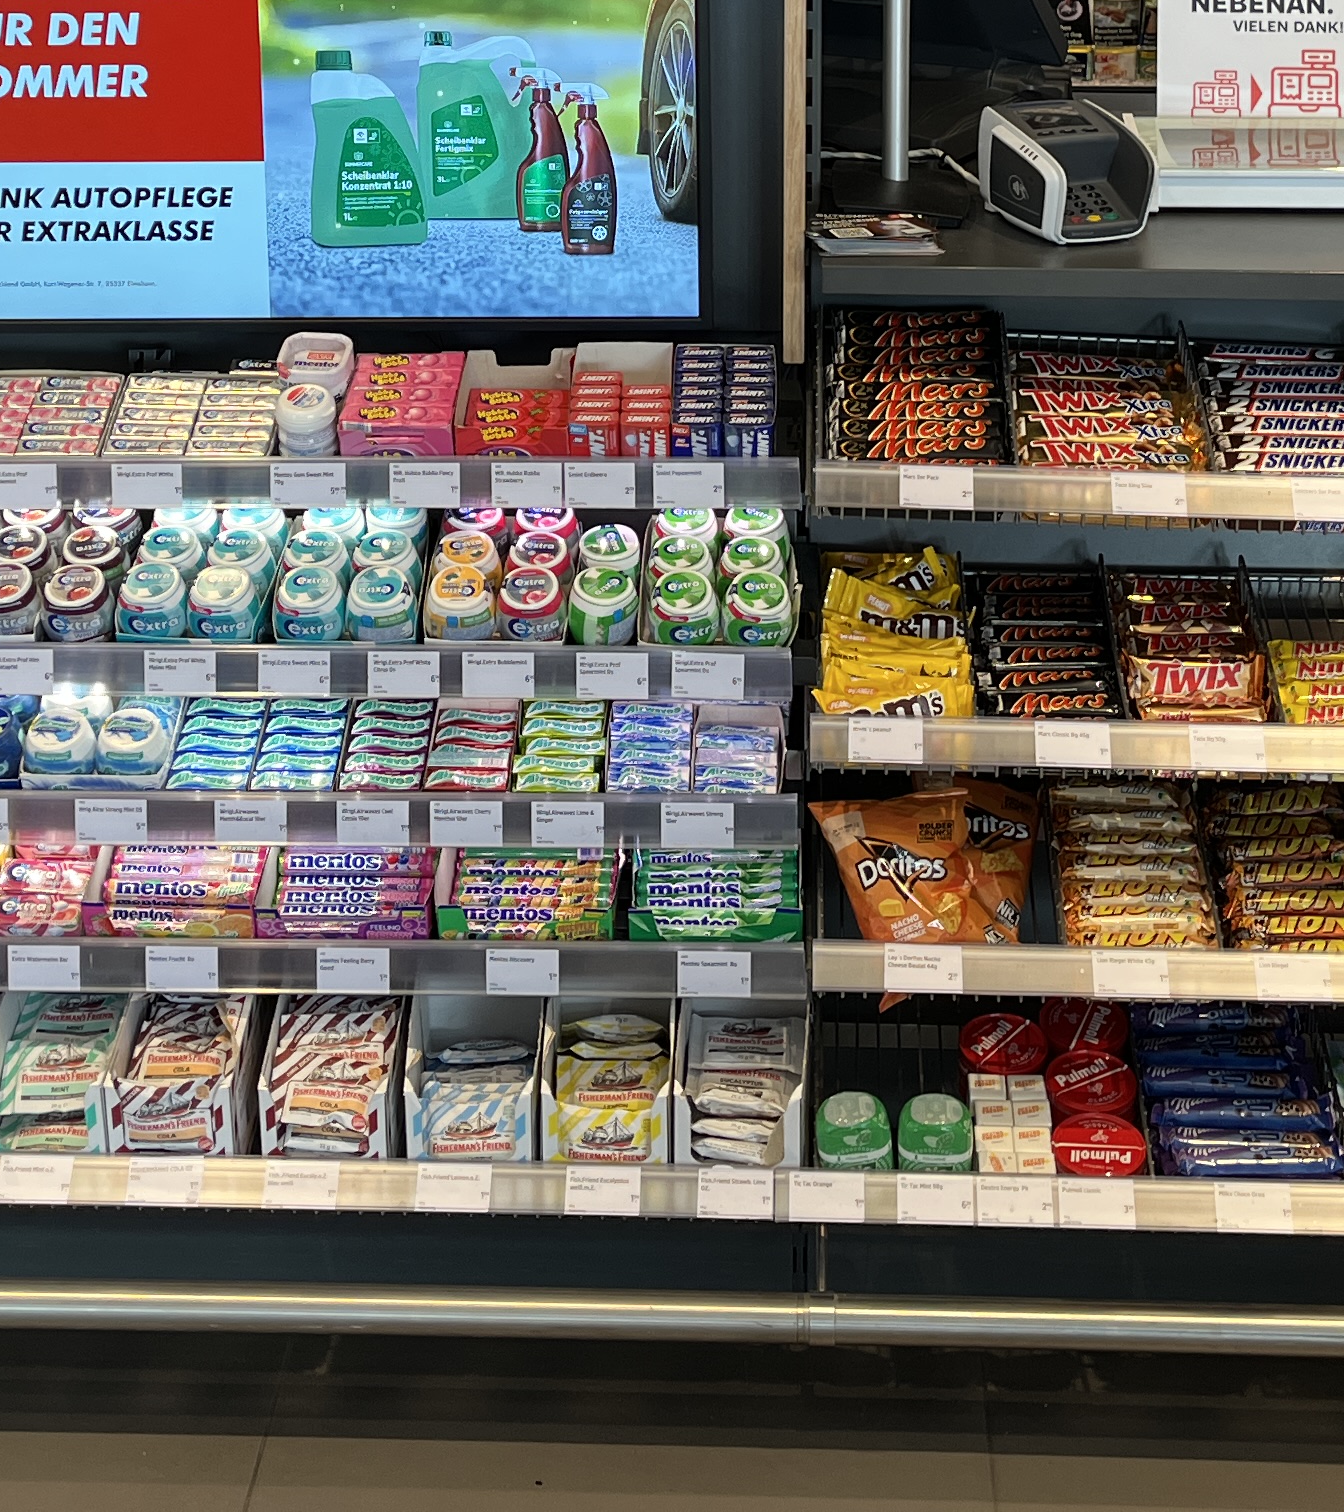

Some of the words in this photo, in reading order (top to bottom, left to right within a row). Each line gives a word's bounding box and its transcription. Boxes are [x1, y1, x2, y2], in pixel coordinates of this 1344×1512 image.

[47, 12, 140, 46] DEN
[1233, 20, 1288, 33] VIELEN
[1294, 21, 1344, 33] DANK!
[342, 171, 399, 180] Scheibenklar
[342, 181, 391, 191] Konzentrat
[51, 186, 233, 208] AUTOPFLEGE
[21, 220, 215, 242] EXTRAKLASSE
[887, 381, 989, 403] Mars
[525, 719, 601, 734] Airwaves
[287, 853, 381, 871] mentos
[115, 879, 207, 897] mentos
[1053, 1058, 1108, 1089] Pulmoll
[126, 1117, 173, 1130] FISHERMAN'S
